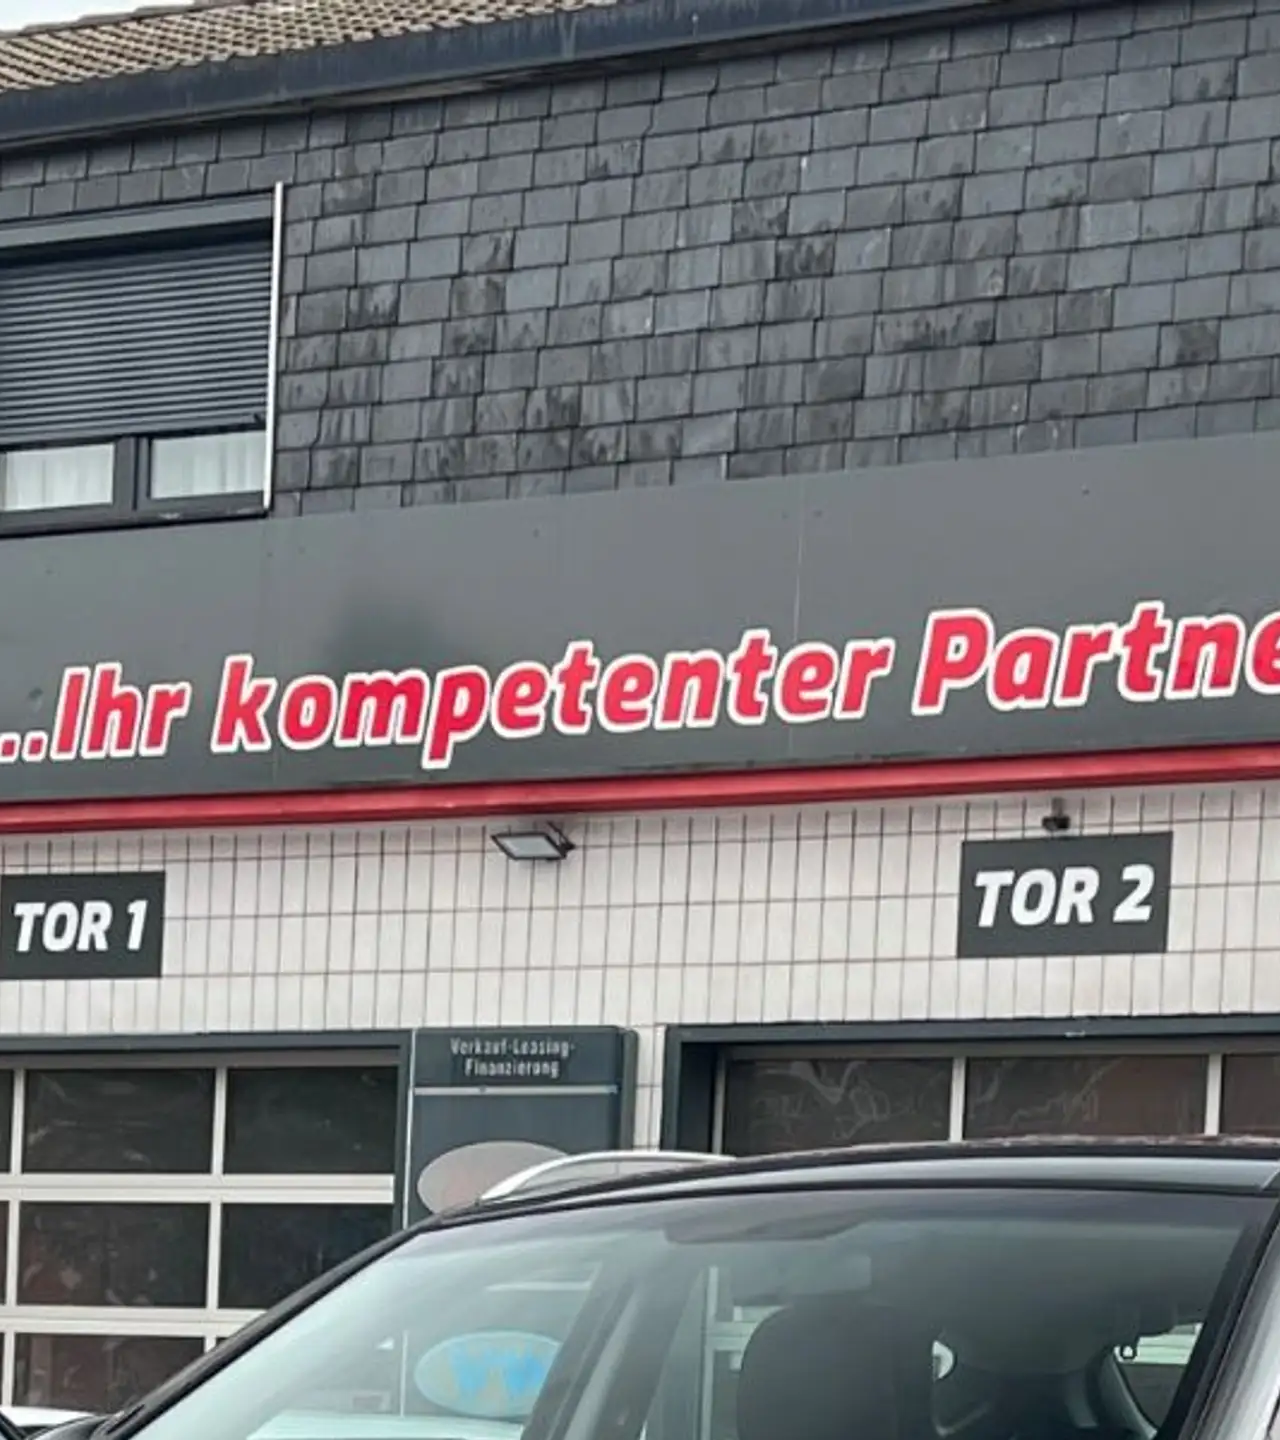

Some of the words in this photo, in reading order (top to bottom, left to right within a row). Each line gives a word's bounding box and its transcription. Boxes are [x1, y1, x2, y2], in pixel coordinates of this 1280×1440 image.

[210, 628, 896, 769] kompetenter
[975, 866, 1100, 927] TOR
[1113, 863, 1155, 922] 2
[13, 901, 114, 952] TOR
[127, 900, 148, 951] 1
[464, 1058, 561, 1079] Finanzierung
